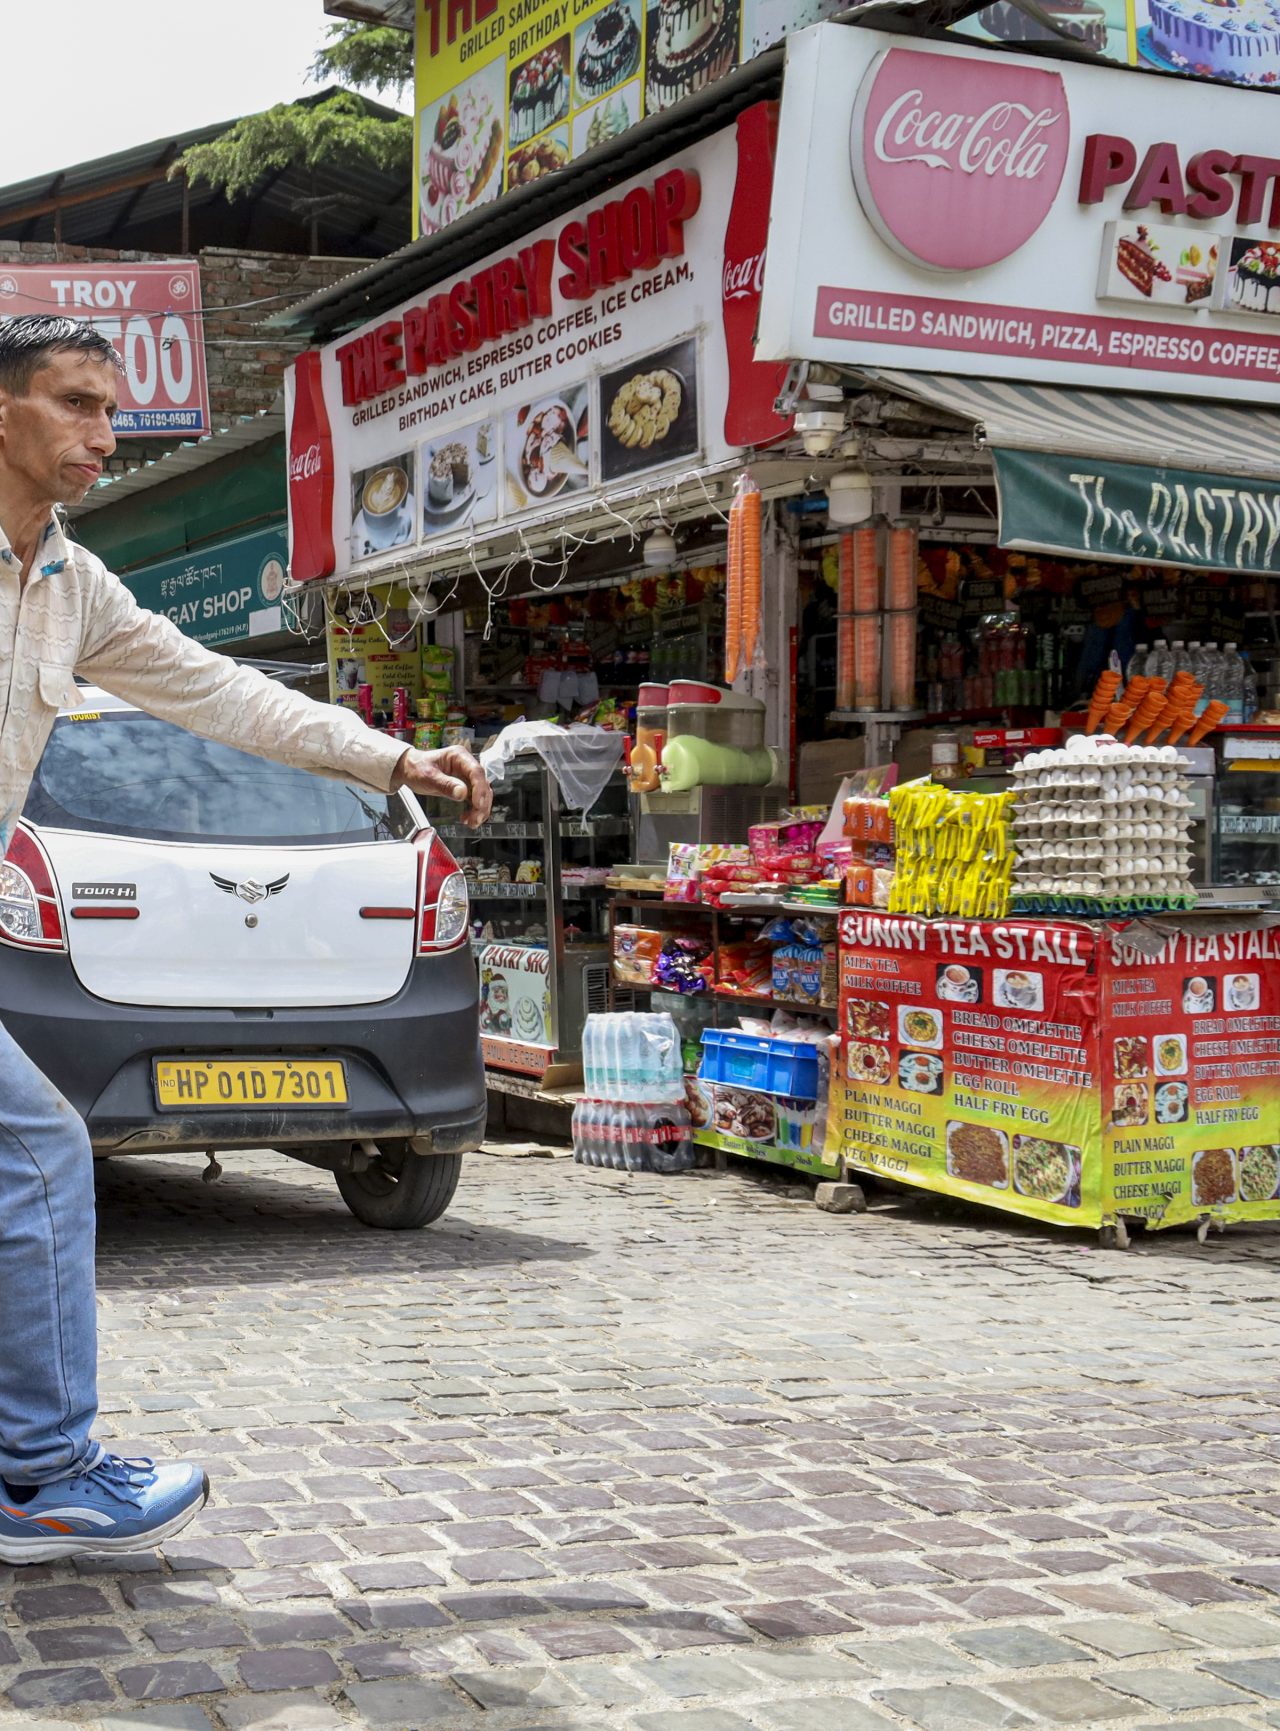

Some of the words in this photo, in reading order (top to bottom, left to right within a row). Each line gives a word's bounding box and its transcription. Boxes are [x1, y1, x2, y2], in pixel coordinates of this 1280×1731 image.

[459, 15, 506, 64] GRILLED
[508, 1, 569, 61] BIRTHDAY
[874, 89, 1063, 180] Coca-Cola
[1078, 133, 1280, 228] PAST
[51, 279, 137, 308] TROY
[335, 321, 407, 407] THE
[402, 238, 556, 378] PASTRY
[558, 168, 702, 300] SHOP
[352, 396, 395, 428] GRILLED
[397, 367, 465, 409] SANDWICH,
[467, 334, 533, 384] ESPRESSO
[536, 310, 598, 349] COFFEE,
[601, 295, 627, 318] ICE
[630, 262, 695, 304] CREAM,
[828, 300, 917, 334] GRILLED
[920, 311, 1037, 352] SANDWICH,
[1041, 322, 1104, 358] PIZZA,
[1108, 331, 1206, 364] ESPRESSO
[398, 399, 457, 433] BIRTHDAY
[458, 382, 497, 412] CAKE,
[499, 354, 553, 390] BUTTER
[554, 323, 623, 367] COOKIES
[111, 414, 137, 430] 6465,
[138, 412, 198, 428] 70180-05887
[1069, 473, 1148, 558] The
[1147, 481, 1280, 570] PASTRY
[202, 586, 253, 619] SHOP
[69, 712, 101, 722] TOURIST
[74, 887, 115, 896] TOUR
[842, 914, 928, 953] SUNNY
[929, 920, 991, 958] TEA
[992, 924, 1087, 966] STALL
[1184, 932, 1220, 963] TEA
[482, 944, 528, 971] PASTRY
[524, 951, 550, 975] SHO
[843, 955, 874, 972] MILK
[875, 957, 900, 974] TEA
[843, 974, 874, 990] MILK
[875, 977, 923, 996] COFFEE
[951, 1010, 1002, 1031] BREAD
[1003, 1016, 1083, 1042] OMELETTE
[1192, 1018, 1225, 1036] BREAD
[952, 1031, 1006, 1052] CHEESE
[1007, 1038, 1088, 1065] OMELETTE
[160, 1079, 176, 1088] IND
[176, 1069, 209, 1099] HP
[952, 1051, 1010, 1073] BUTTER
[1011, 1060, 1093, 1089] OMELETTE
[1235, 1059, 1280, 1078] OMELETT
[953, 1072, 983, 1091] EGG
[983, 1077, 1020, 1097] ROLL
[843, 1089, 882, 1109] PLAIN
[883, 1096, 923, 1117] MAGGI
[953, 1093, 990, 1112] HALF
[991, 1100, 1019, 1119] FRY
[1021, 1106, 1050, 1125] EGG
[843, 1108, 893, 1130] BUTTER
[895, 1118, 937, 1139] MAGGI
[843, 1127, 890, 1148] CHEESE
[891, 1136, 932, 1159] MAGGI
[1113, 1139, 1142, 1154] PLAIN
[1143, 1136, 1175, 1151] MAGGI
[843, 1145, 867, 1163] VEG
[868, 1151, 909, 1173] MAGGI
[1113, 1160, 1153, 1177] BUTTER
[1153, 1158, 1185, 1173] MAGGI
[1113, 1183, 1151, 1200] CHEESE
[1151, 1181, 1182, 1197] MAGGI
